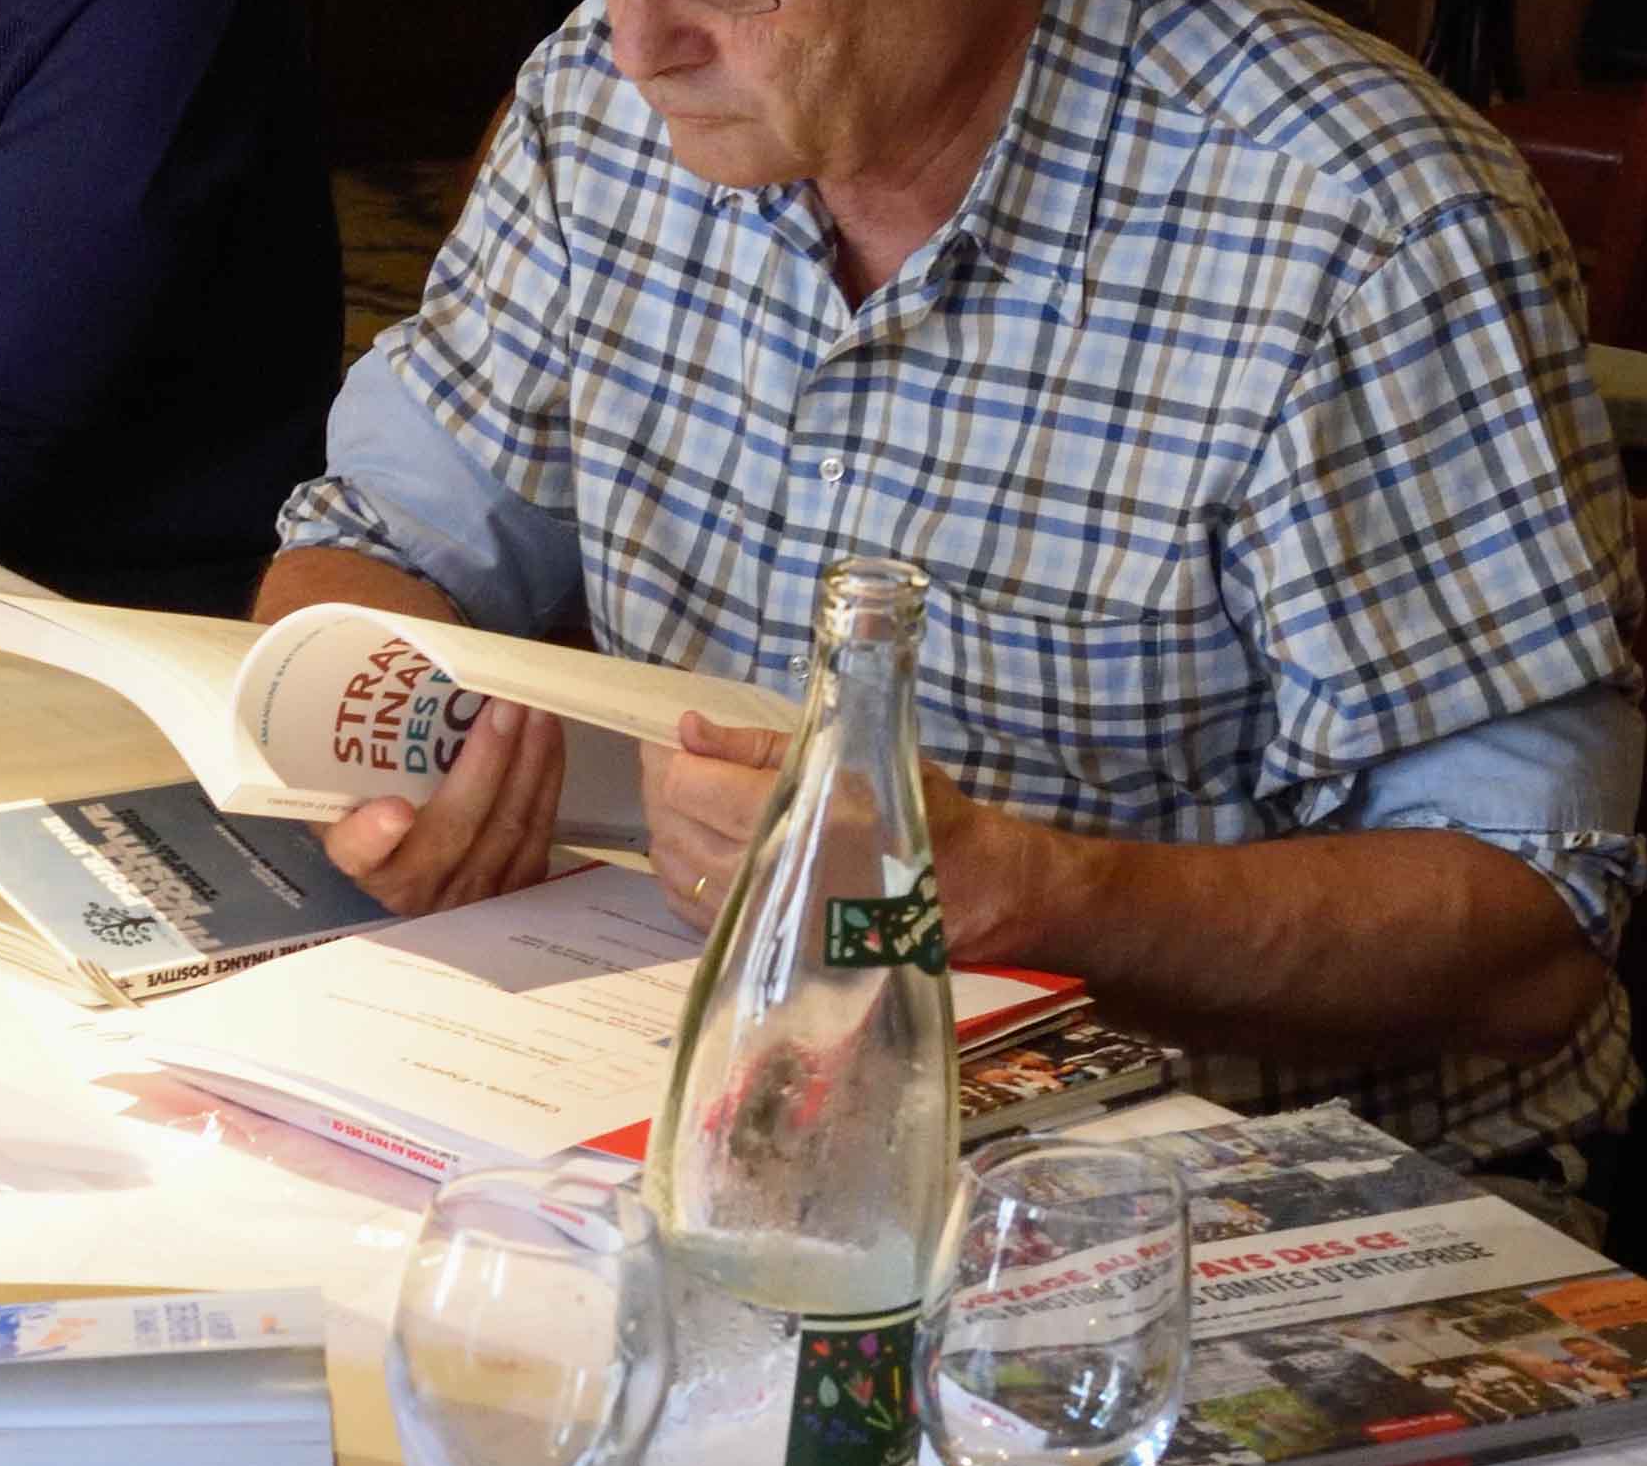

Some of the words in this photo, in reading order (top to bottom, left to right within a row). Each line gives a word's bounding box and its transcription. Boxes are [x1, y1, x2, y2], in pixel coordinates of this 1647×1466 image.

[405, 696, 440, 774] DES
[146, 965, 209, 988] POSITIVE
[1201, 1267, 1322, 1303] COMITÉS
[1312, 1240, 1496, 1284] D'ENTREPRISE
[1274, 1239, 1356, 1265] DES
[1355, 1230, 1410, 1251] CE
